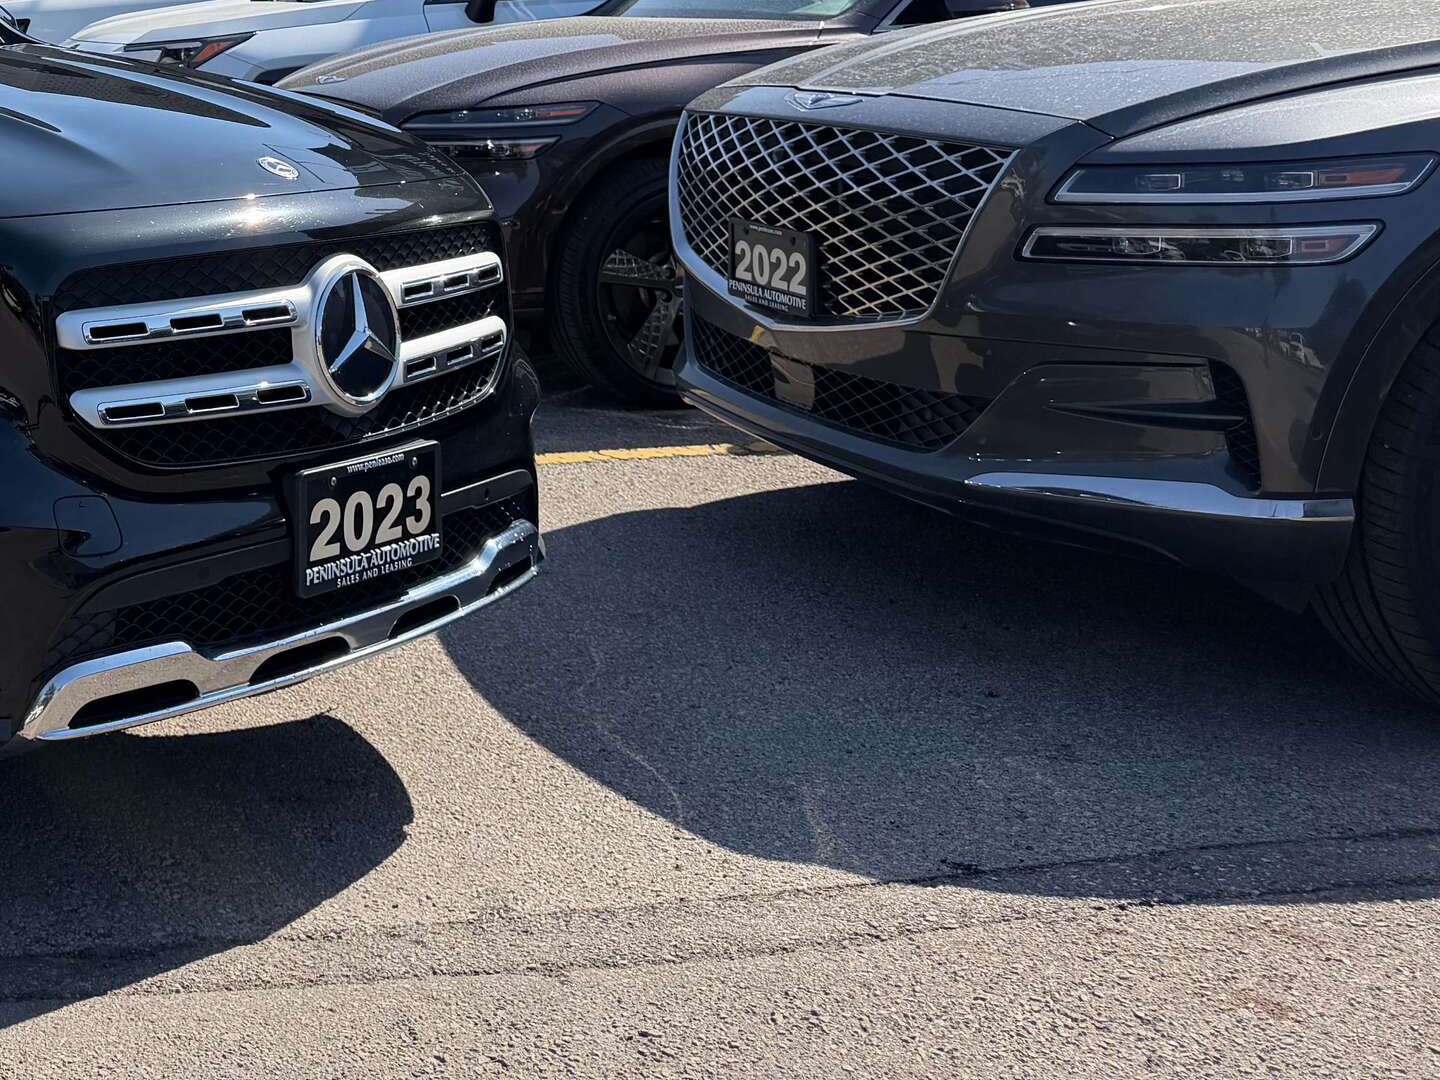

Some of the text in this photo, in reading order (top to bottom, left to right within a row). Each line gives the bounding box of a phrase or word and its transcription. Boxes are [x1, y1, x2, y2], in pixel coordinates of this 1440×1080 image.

[728, 279, 807, 310] PENINSULA AUTOMOTIVE
[735, 240, 807, 296] 2022
[310, 475, 432, 562] 2023
[305, 533, 440, 586] PENINSULA AUTOMOTIVE
[337, 558, 413, 588] SALES AND LEASING
